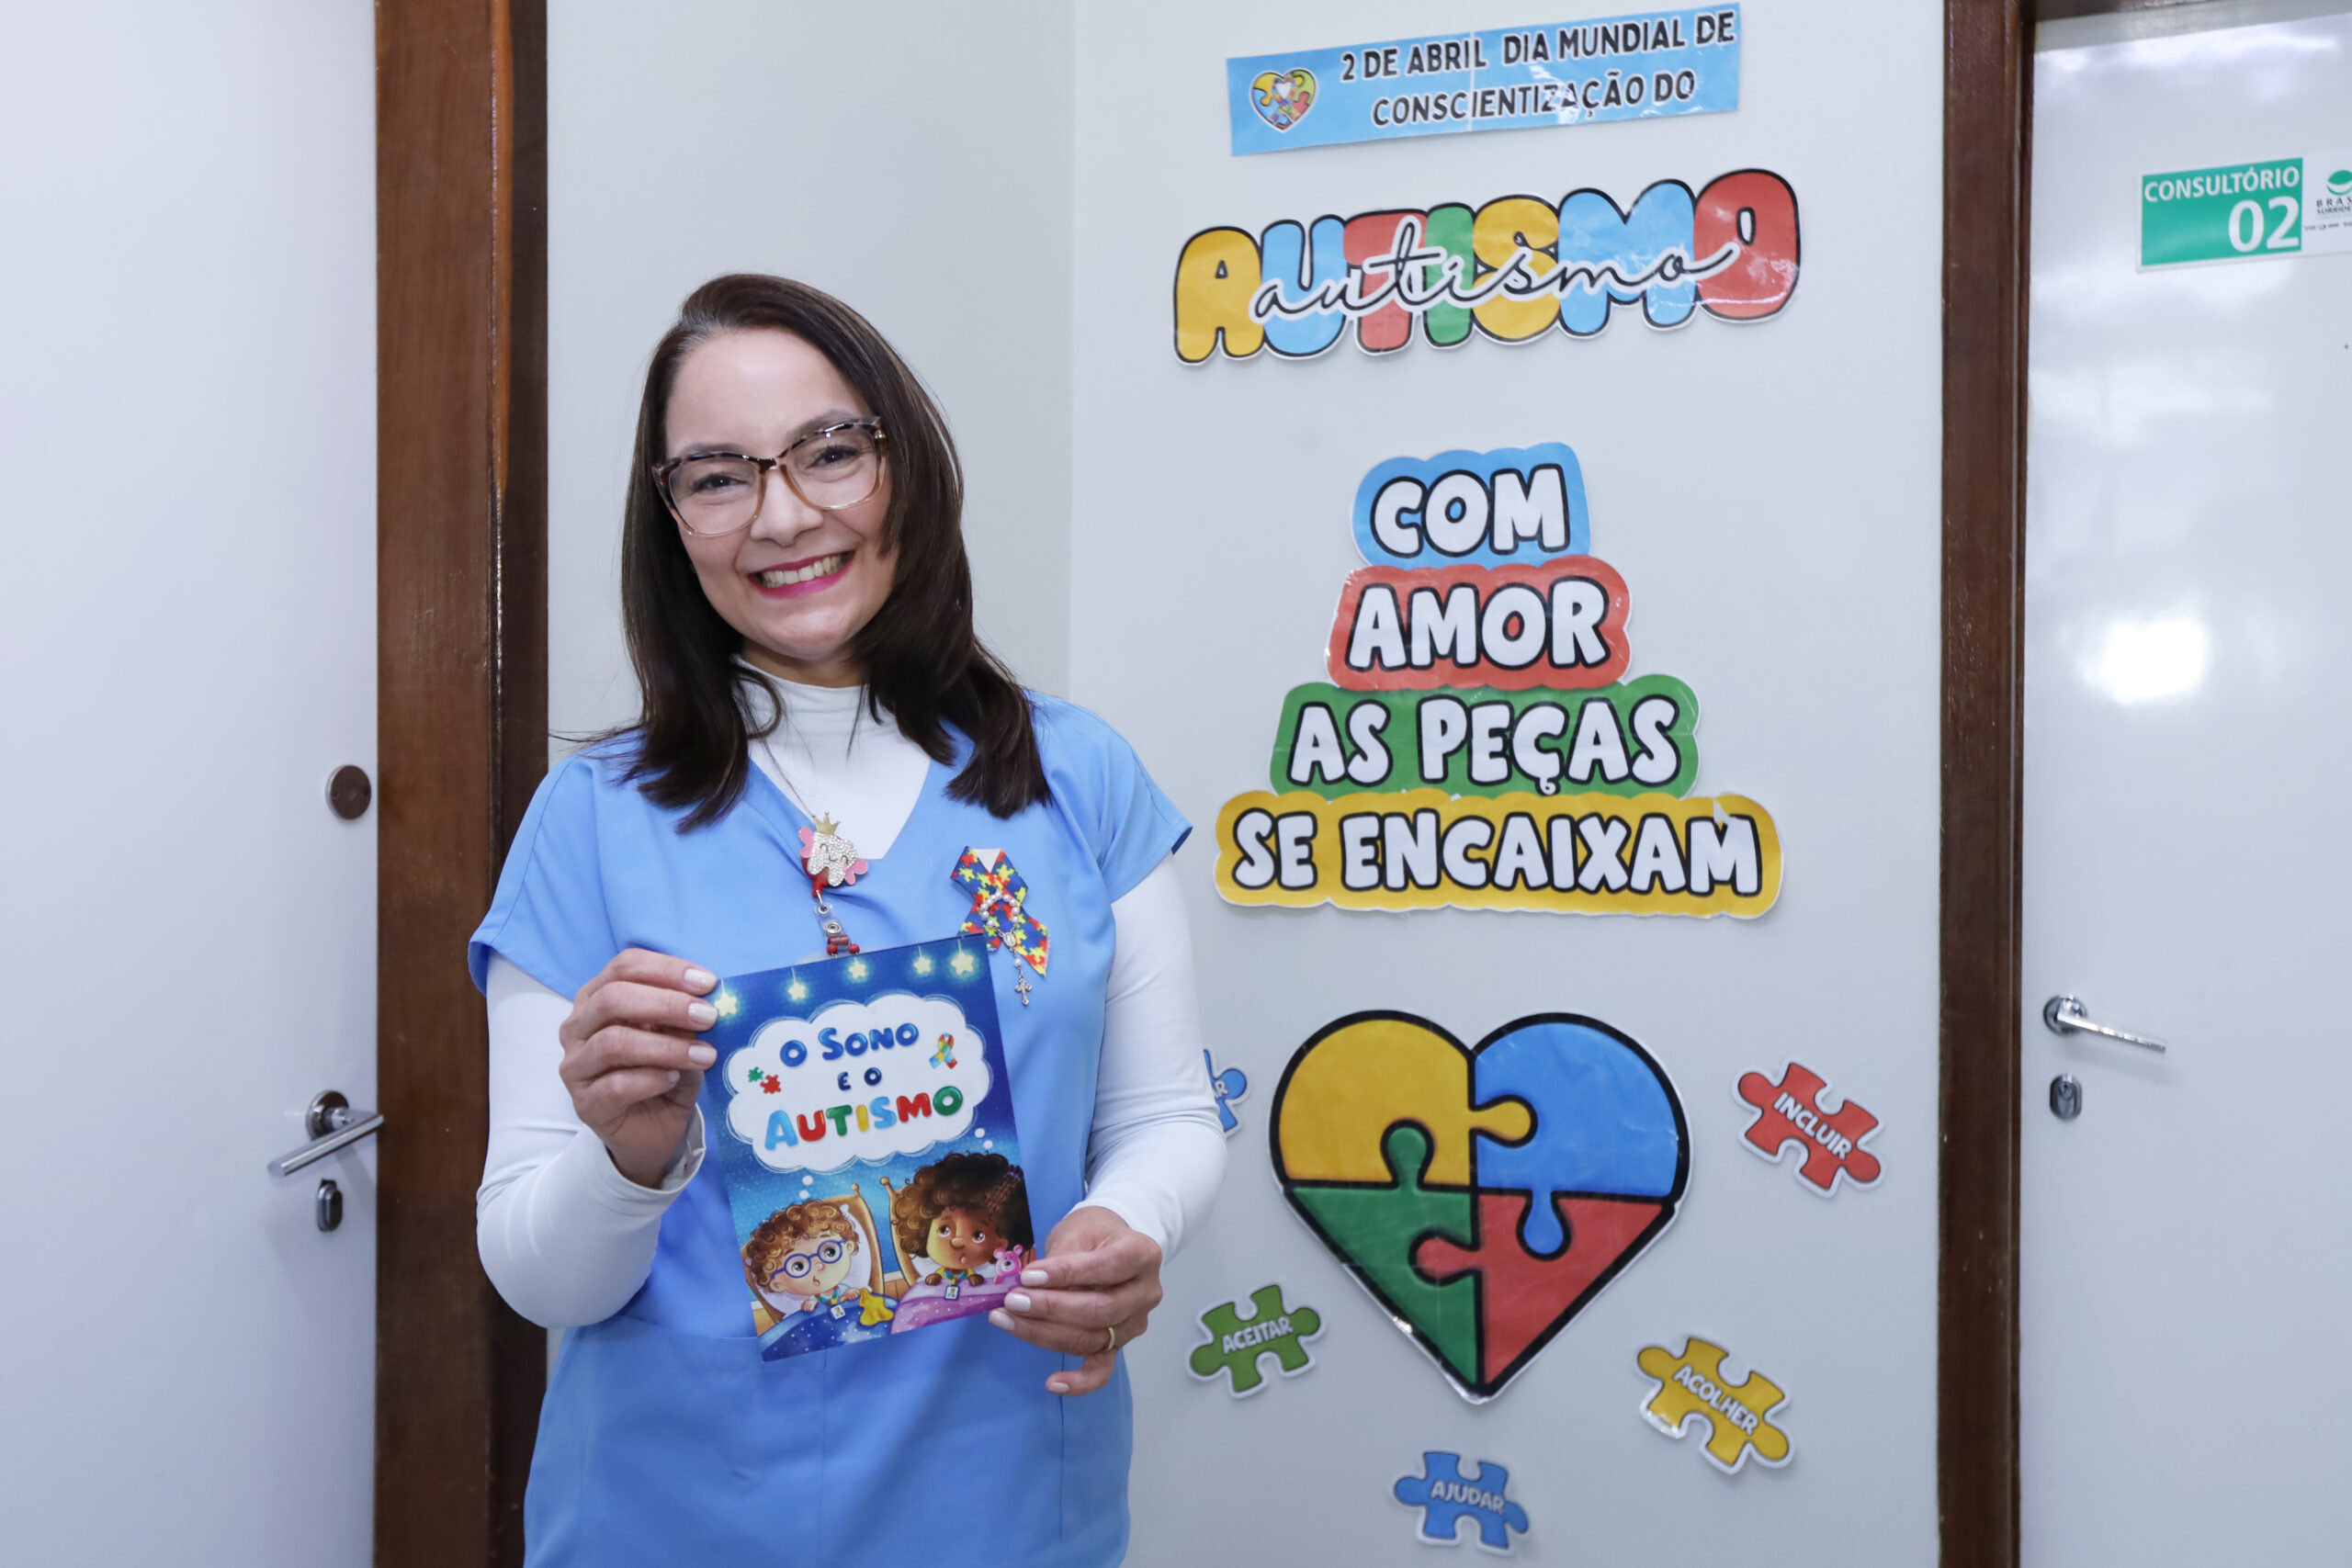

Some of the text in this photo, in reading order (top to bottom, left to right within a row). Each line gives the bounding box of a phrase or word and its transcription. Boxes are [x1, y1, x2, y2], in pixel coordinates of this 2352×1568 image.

[1341, 11, 1735, 81] 2 DE ABRIL DIA MUNDIAL DE
[1373, 70, 1695, 126] CONSCIENTIZAÇÃO DO
[2143, 166, 2301, 202] CONSULTÓRIO
[2228, 195, 2301, 253] 02
[1173, 168, 1802, 364] AUTISMO
[1254, 220, 1736, 317] autismo
[1370, 463, 1571, 558] COM
[1345, 576, 1612, 671] AMOR
[1286, 694, 1681, 796] AS PEÇAS
[1231, 807, 1763, 897] SE ENCAIXAM
[779, 1039, 808, 1067] O
[837, 1067, 882, 1091] E O
[763, 1085, 963, 1150] AUTISMO
[1773, 1091, 1852, 1159] INCLUIR
[1223, 1316, 1294, 1354] ACEITAR
[1673, 1365, 1758, 1436] ACOLHER
[1430, 1480, 1505, 1516] AJUDAR
